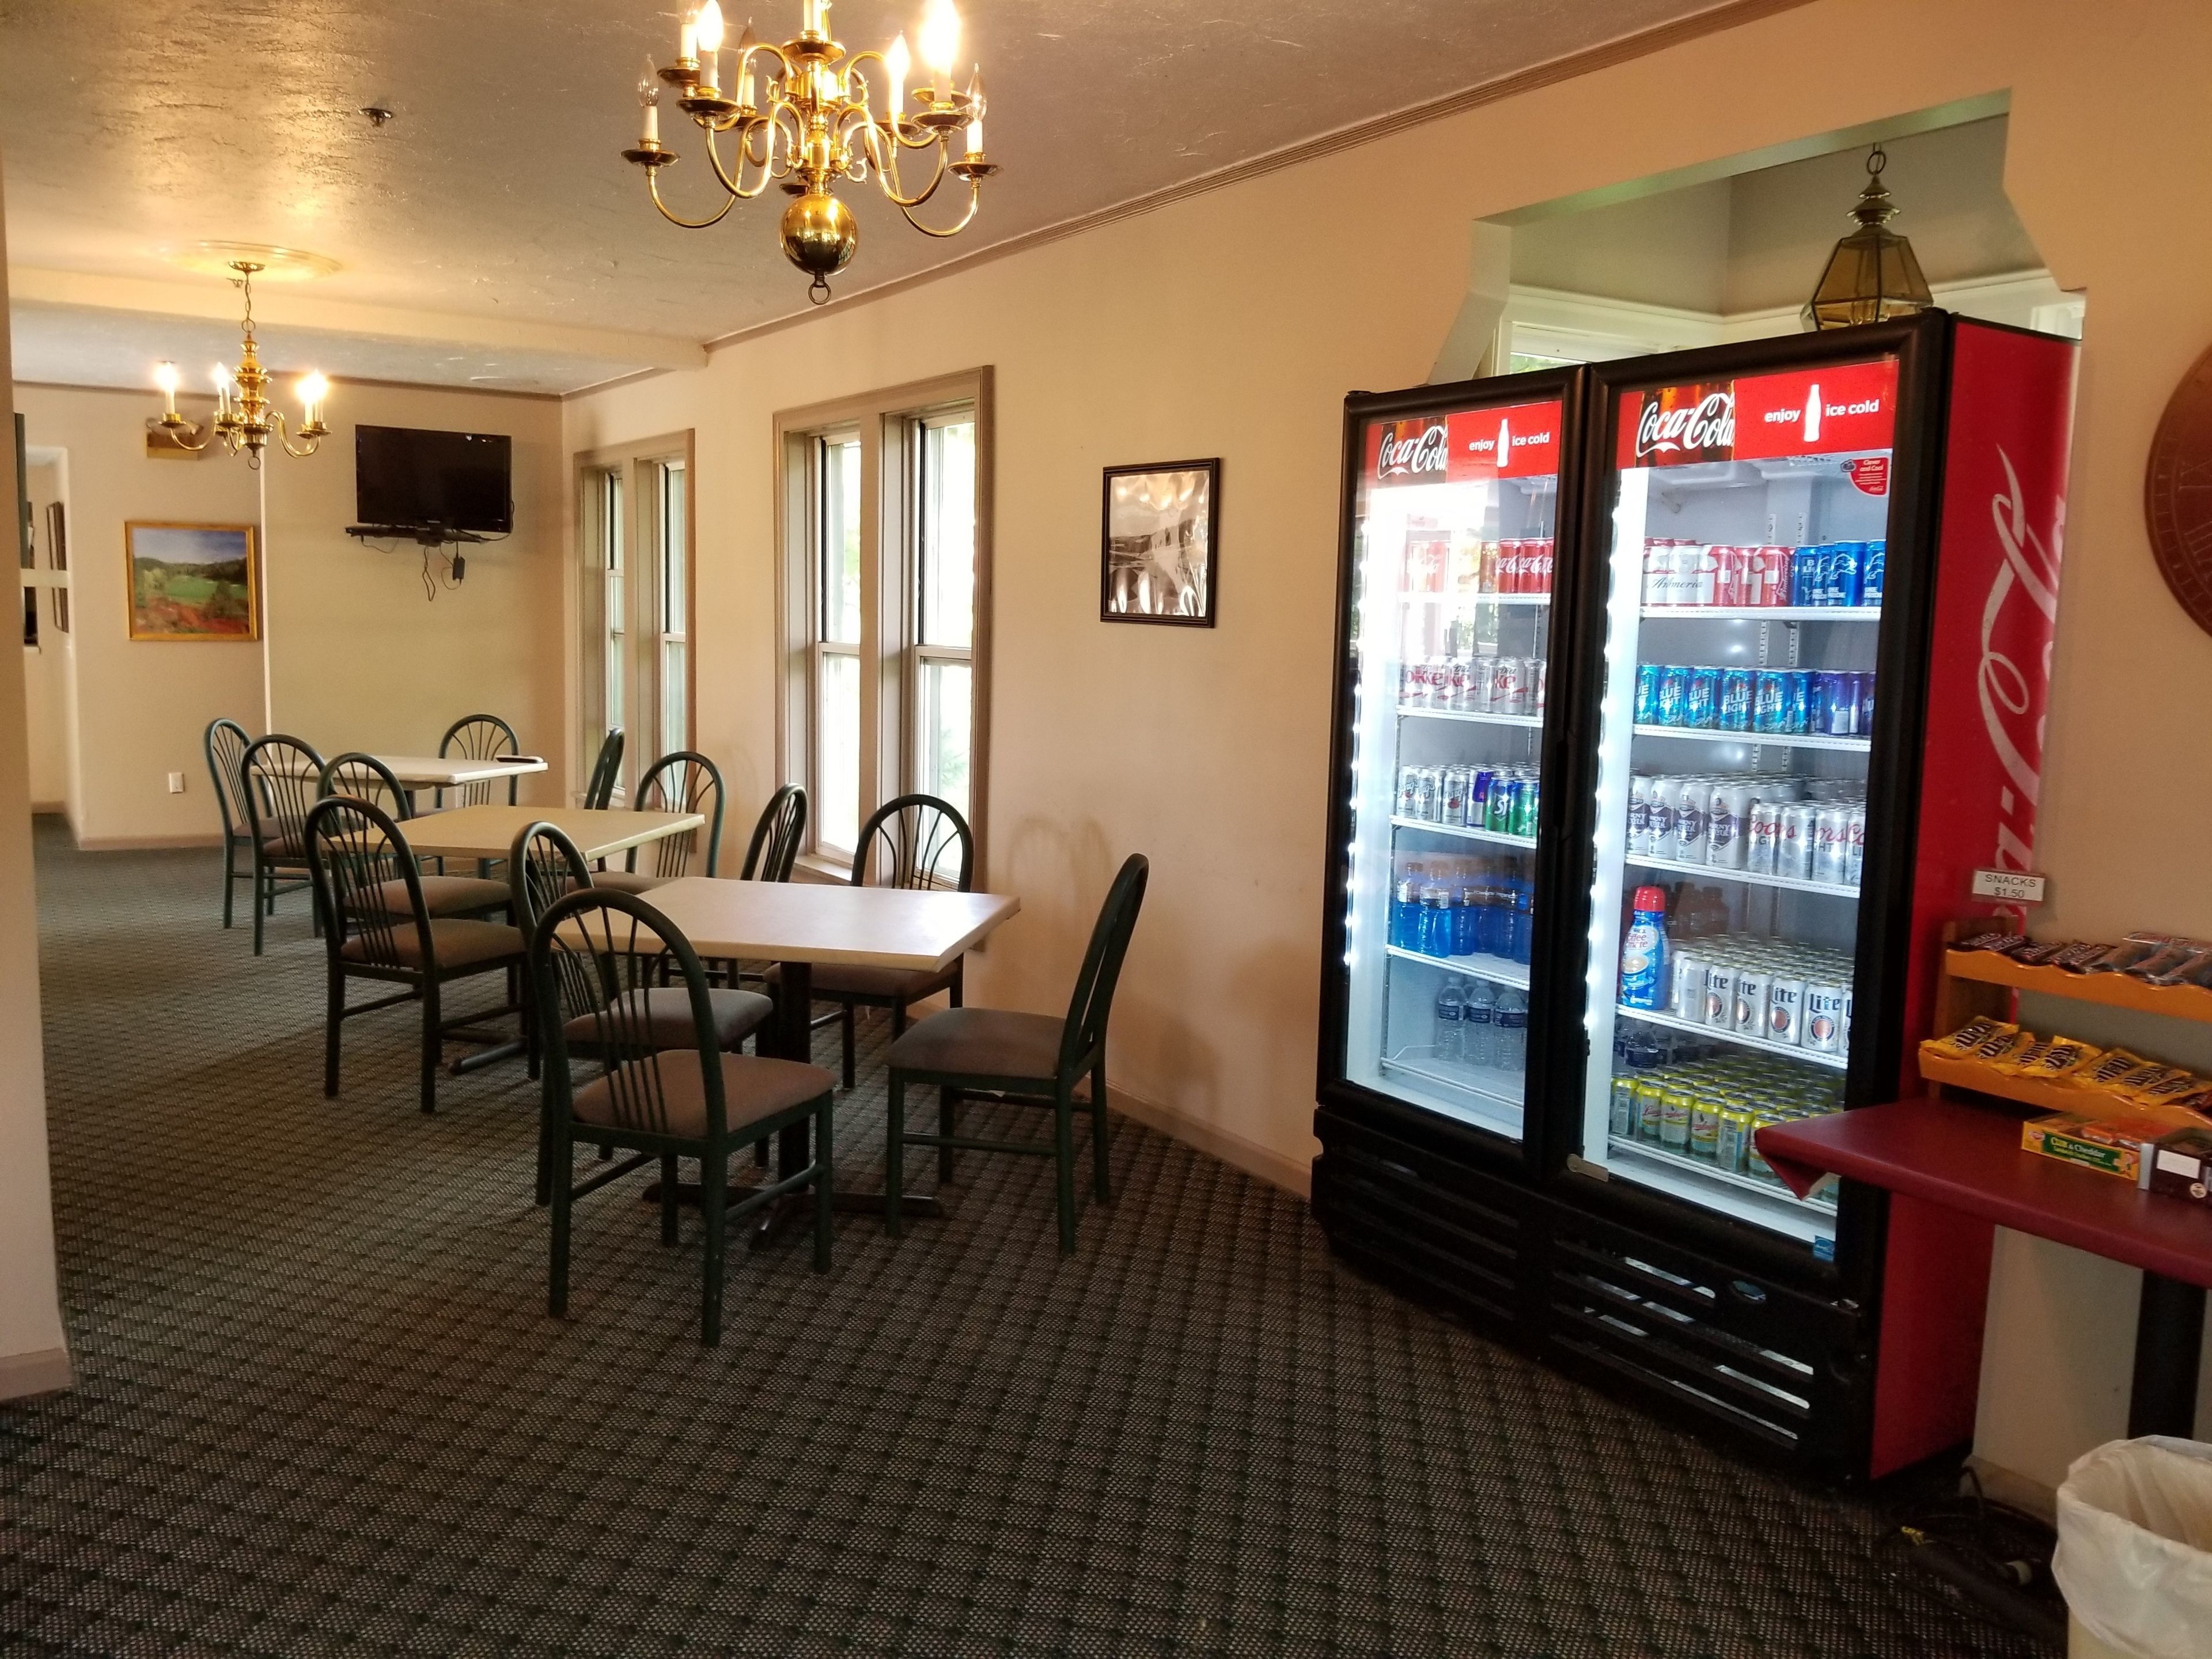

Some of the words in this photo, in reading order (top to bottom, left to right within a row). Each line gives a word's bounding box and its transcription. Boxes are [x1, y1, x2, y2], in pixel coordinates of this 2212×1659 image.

[1764, 408, 1801, 423] enjoy
[1825, 404, 1846, 417] ice
[1847, 399, 1880, 415] cold
[1635, 393, 1734, 458] Coca-Cola
[1468, 439, 1495, 452] enjoy
[1512, 435, 1527, 447] ice
[1527, 432, 1550, 445] cold
[1377, 426, 1448, 480] Coca-Cola
[1723, 690, 1753, 704] BLUE
[1985, 874, 2036, 888] SNACKS
[1994, 887, 2025, 899] $1.50
[1703, 969, 1729, 990] Lite
[1808, 993, 1840, 1014] Lite
